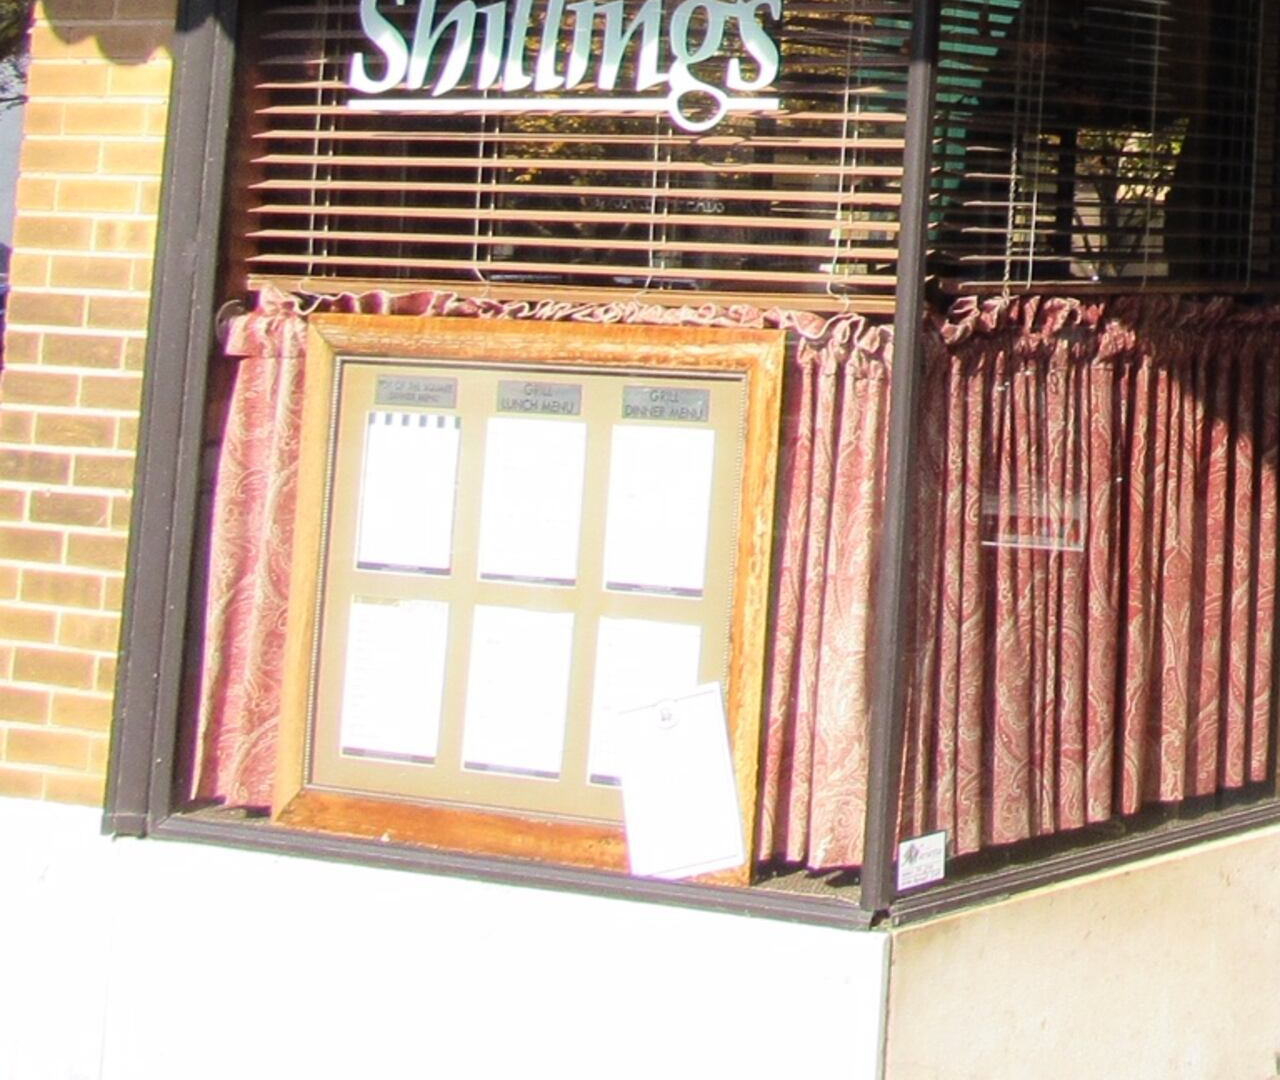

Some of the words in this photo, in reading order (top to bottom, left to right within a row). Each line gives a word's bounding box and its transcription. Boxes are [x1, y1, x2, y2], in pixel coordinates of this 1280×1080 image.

[649, 389, 680, 403] GRILL
[502, 397, 538, 411] LUNCH
[541, 400, 575, 414] MENU
[624, 404, 666, 418] DINNER
[668, 406, 704, 421] MENU
